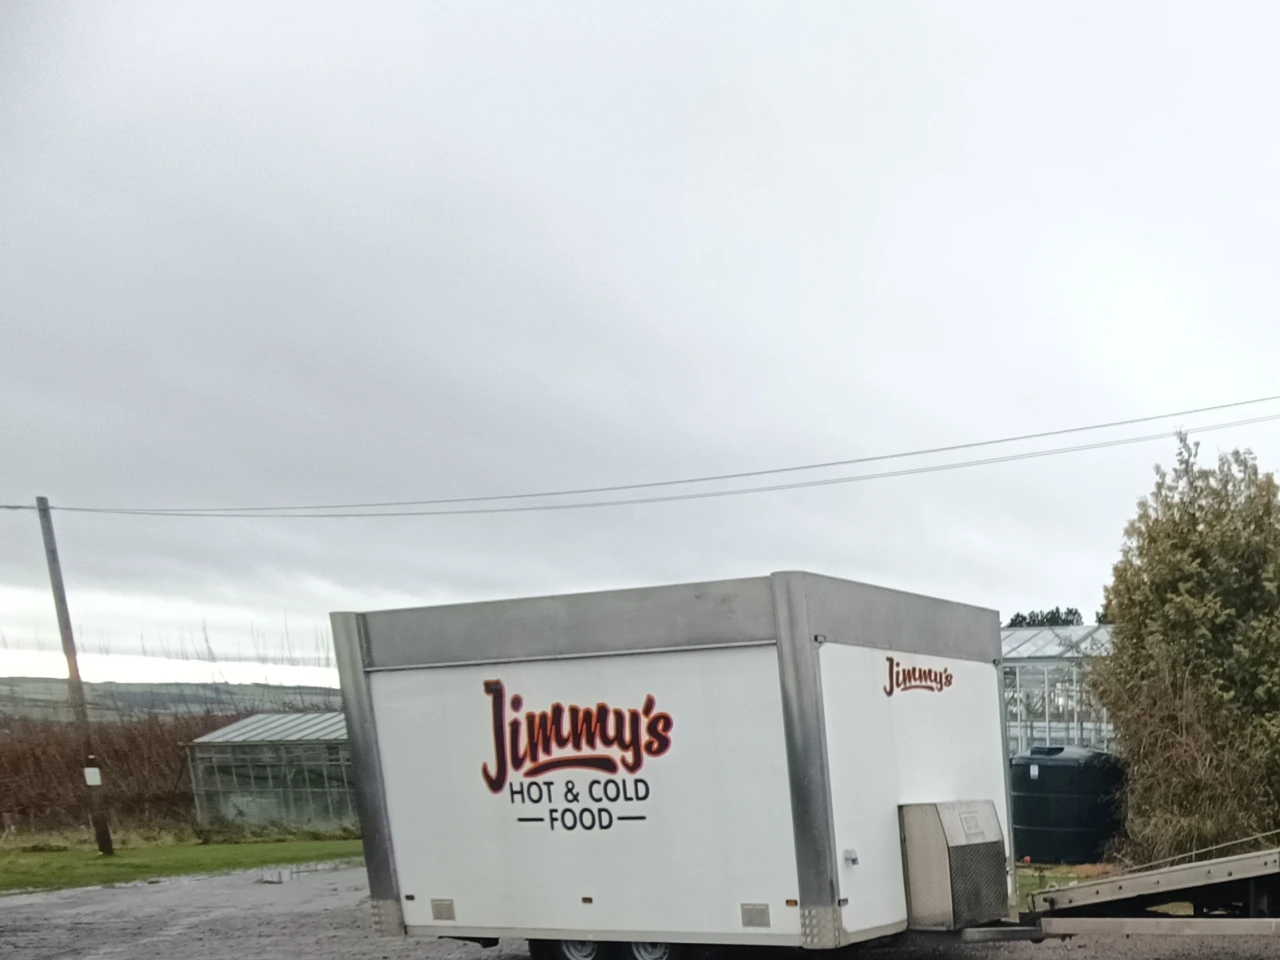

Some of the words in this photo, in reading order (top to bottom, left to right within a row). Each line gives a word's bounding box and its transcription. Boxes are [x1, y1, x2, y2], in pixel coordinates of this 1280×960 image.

[883, 656, 953, 697] Jimmy's
[482, 679, 673, 794] Jimmy's
[509, 781, 554, 804] HOT
[564, 780, 580, 803] &
[588, 778, 650, 802] COLD
[549, 808, 613, 831] FOOD
